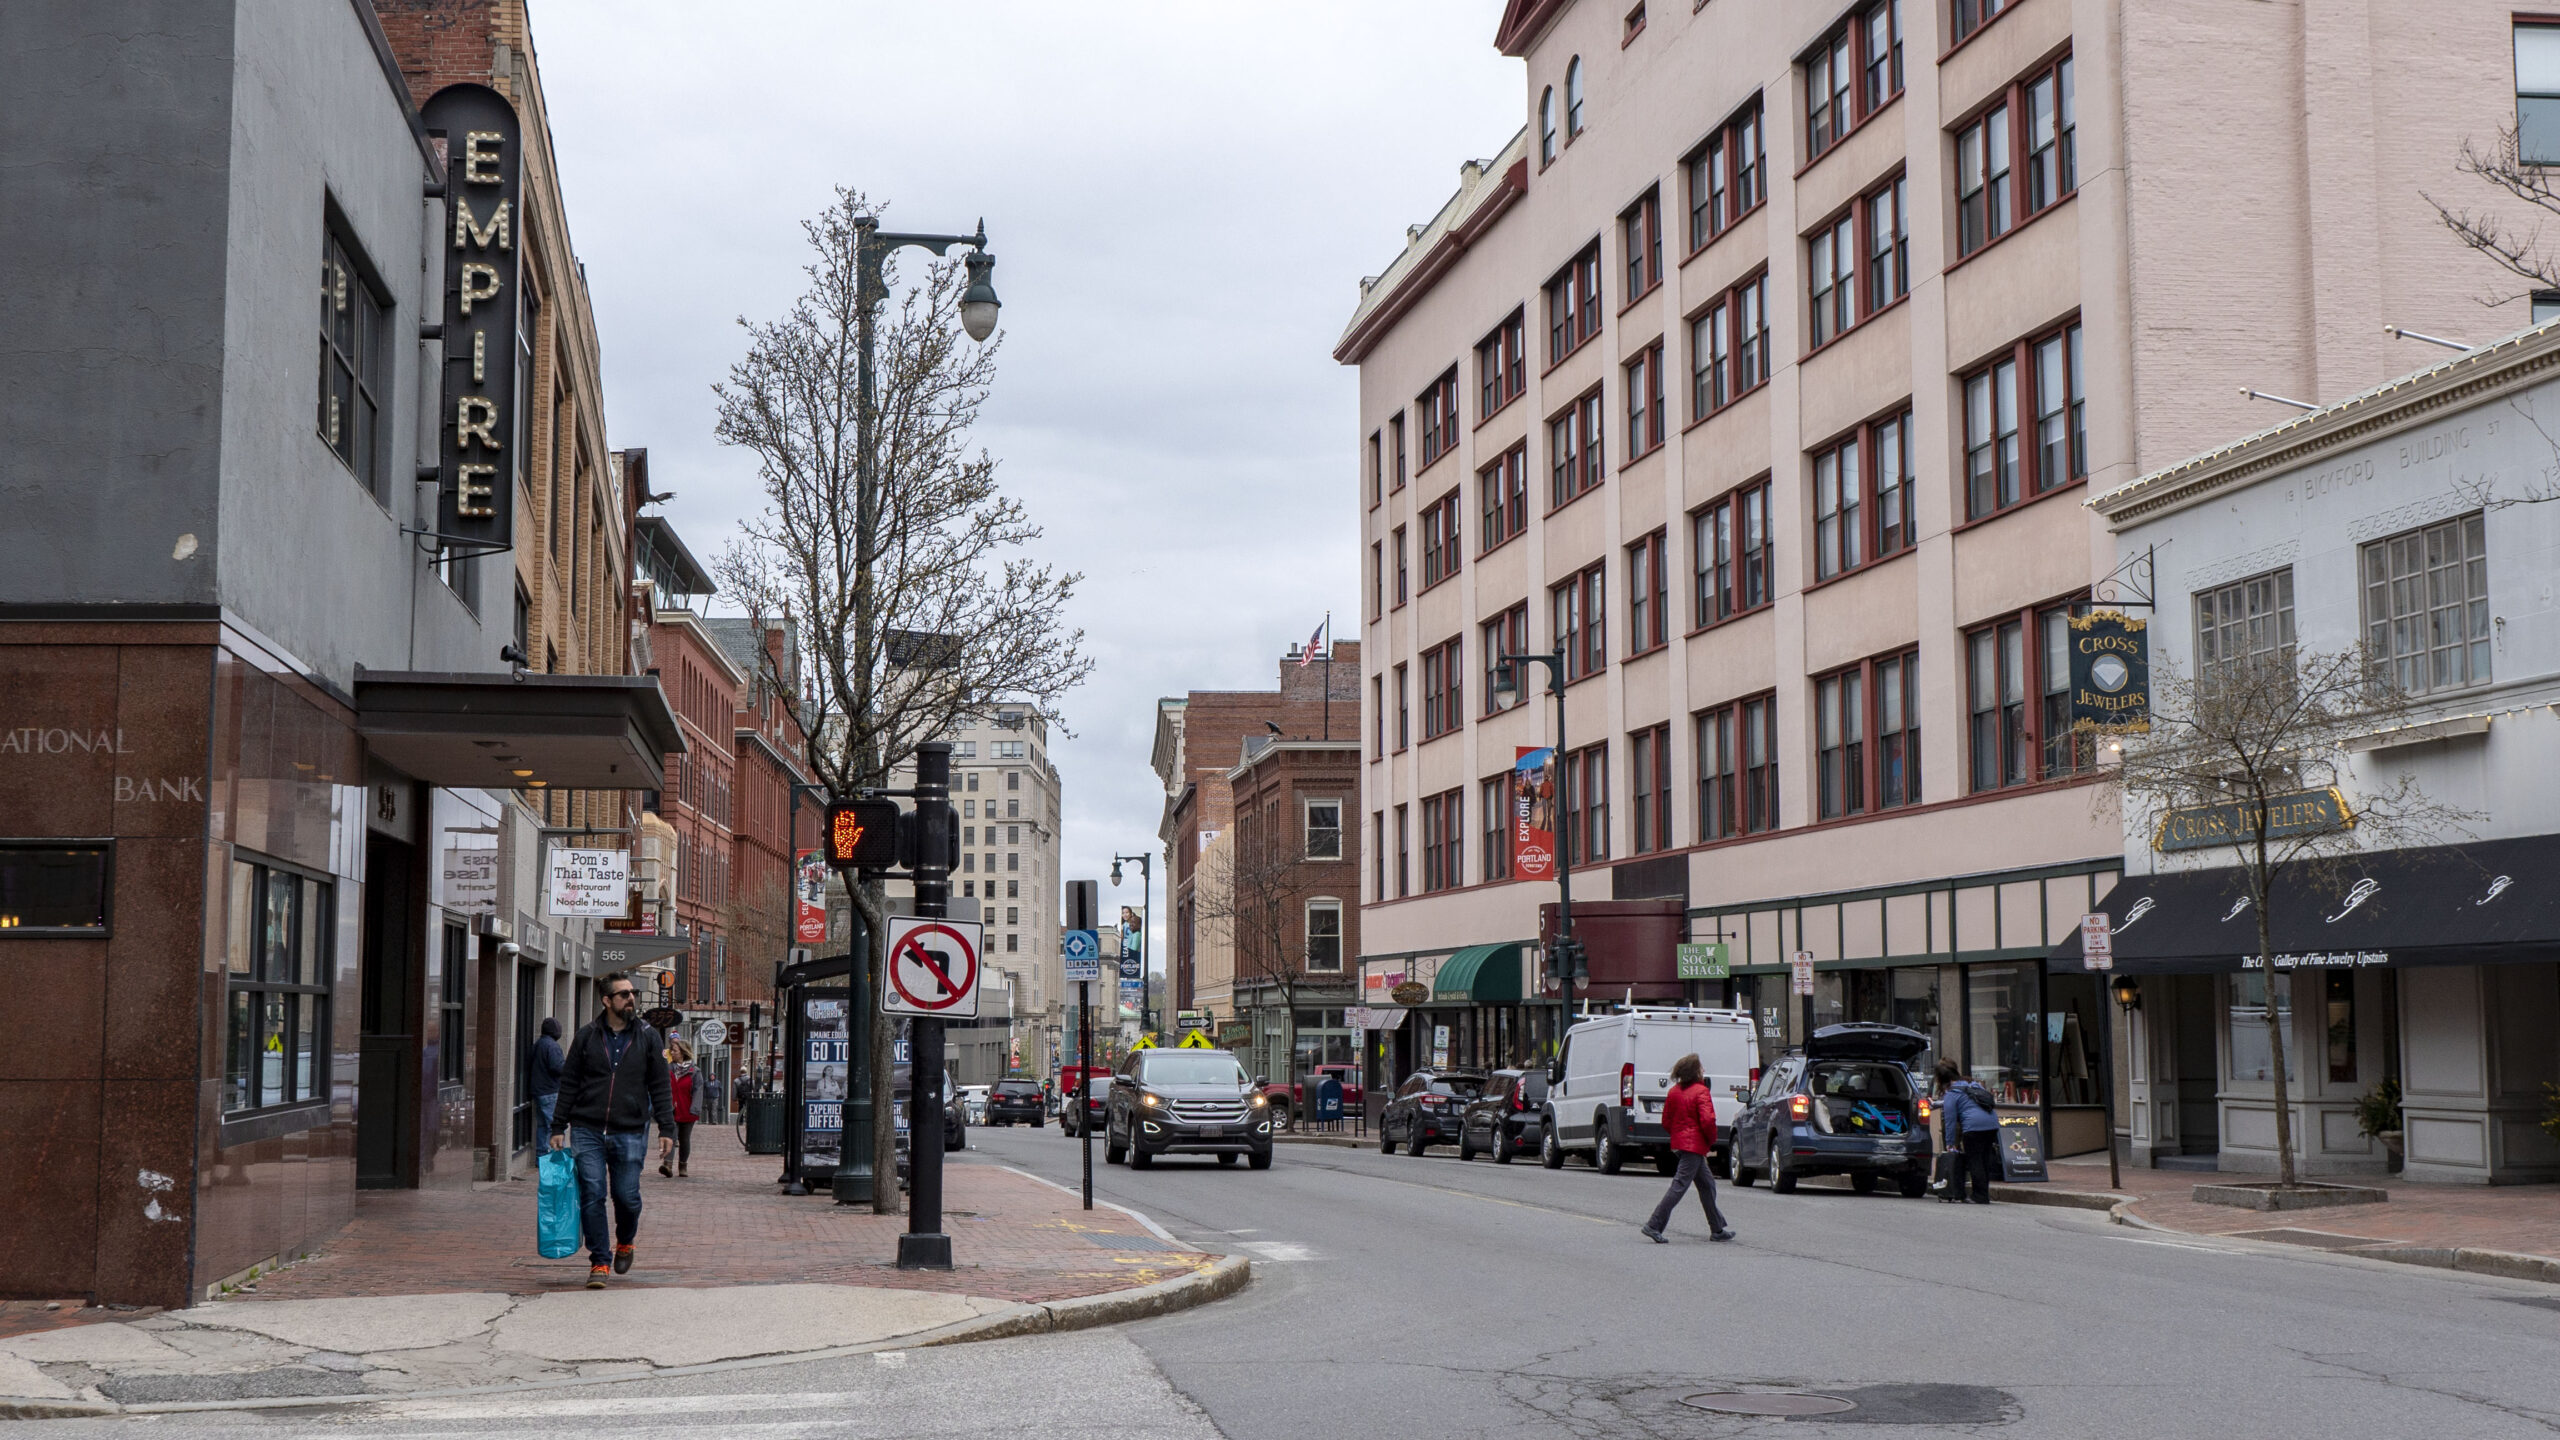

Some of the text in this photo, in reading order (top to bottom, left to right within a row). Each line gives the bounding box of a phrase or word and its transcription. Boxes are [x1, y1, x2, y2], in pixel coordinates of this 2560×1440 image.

[454, 131, 513, 517] EMPIRE
[2305, 460, 2374, 500] BICKFORD
[2400, 427, 2470, 469] BUILDING
[2079, 635, 2138, 654] CROSS
[2076, 688, 2145, 711] JEWELERS
[0, 728, 134, 753] ATIONAL
[114, 776, 203, 801] BANK
[1519, 796, 1530, 841] EXPLORE
[2172, 814, 2226, 841] CROSS
[571, 853, 609, 866] Pom's
[1517, 853, 1552, 863] PORTLAND
[554, 867, 624, 880] Thai Taste
[566, 882, 611, 891] Restaurant
[556, 898, 619, 907] Noodle House
[2089, 917, 2100, 925] NO
[602, 951, 625, 961] 565
[2242, 957, 2254, 968] The
[2274, 954, 2300, 968] Gallery
[2300, 953, 2309, 965] of
[2309, 953, 2325, 965] Fine
[2326, 952, 2356, 967] Jewelry
[2357, 950, 2388, 967] Upstairs
[1682, 966, 1726, 976] SHACK
[812, 1042, 848, 1061] GO TO
[809, 1103, 842, 1115] EXPERIE
